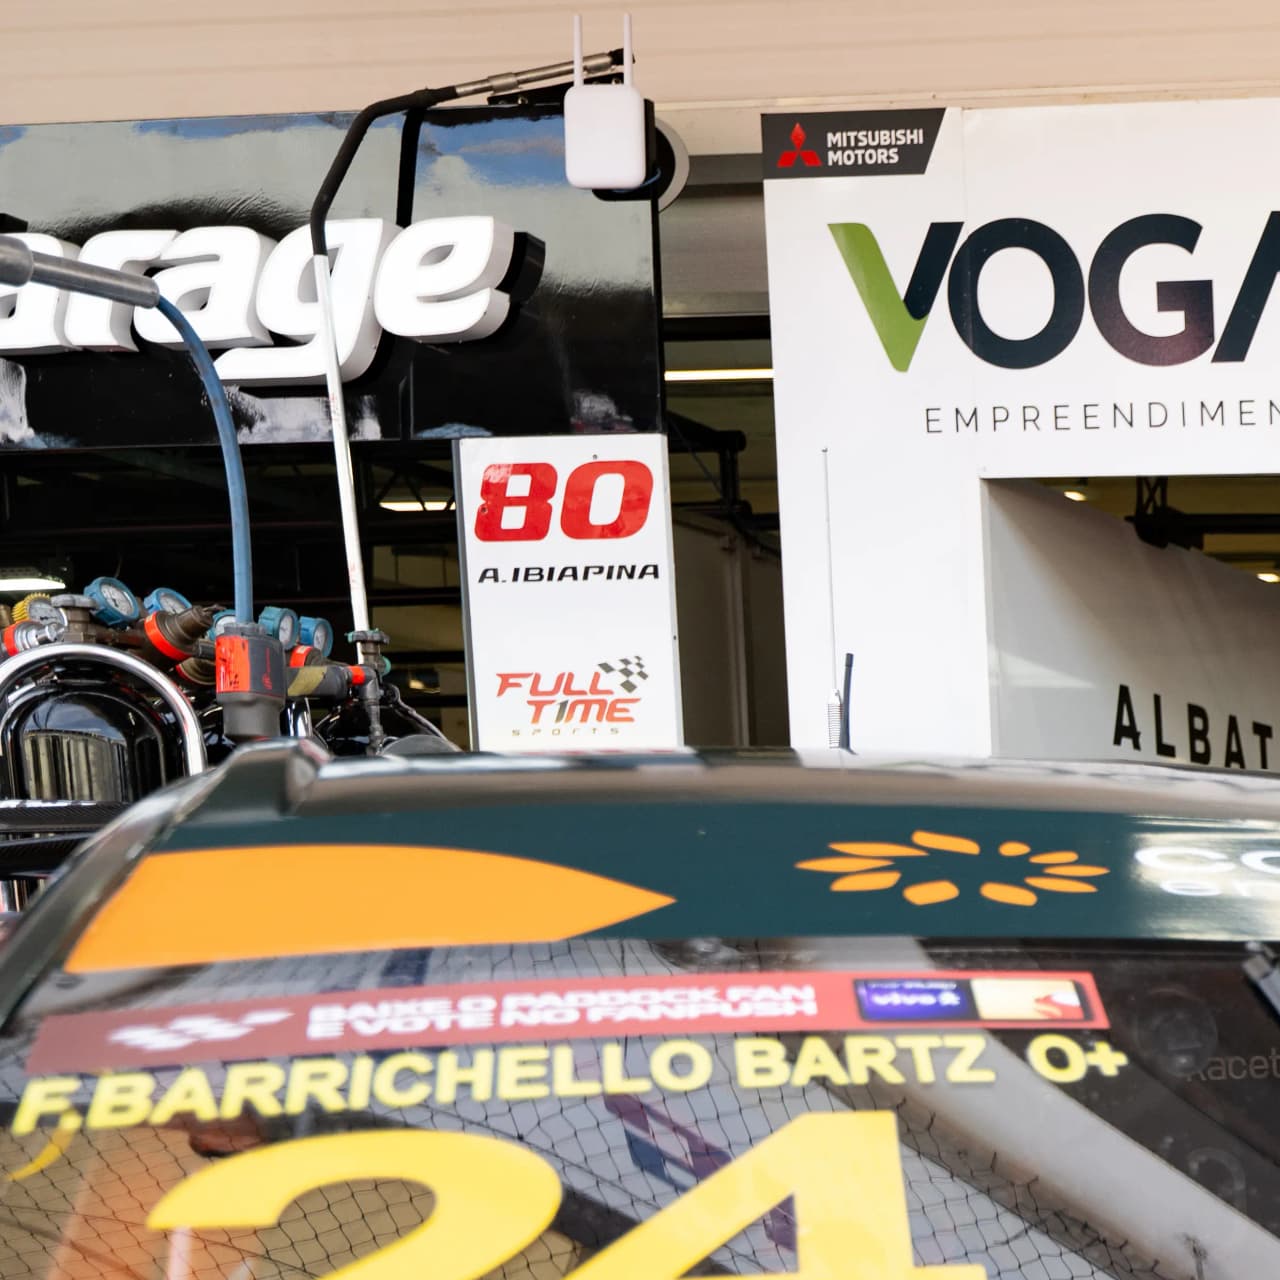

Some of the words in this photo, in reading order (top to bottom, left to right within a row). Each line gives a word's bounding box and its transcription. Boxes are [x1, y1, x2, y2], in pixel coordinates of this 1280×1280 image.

[826, 128, 924, 148] MITSUBISHI
[826, 147, 900, 166] MOTORS
[474, 460, 654, 542] 80
[478, 564, 659, 583] A.IBIAPINA
[496, 671, 615, 697] FULL
[726, 984, 817, 1003] FAN
[351, 1011, 495, 1036] VOTE
[501, 1006, 583, 1028] NO
[585, 999, 819, 1024] FANPUSH
[10, 1038, 713, 1137] F.BARRICHELLO
[735, 1034, 996, 1089] BARTZ
